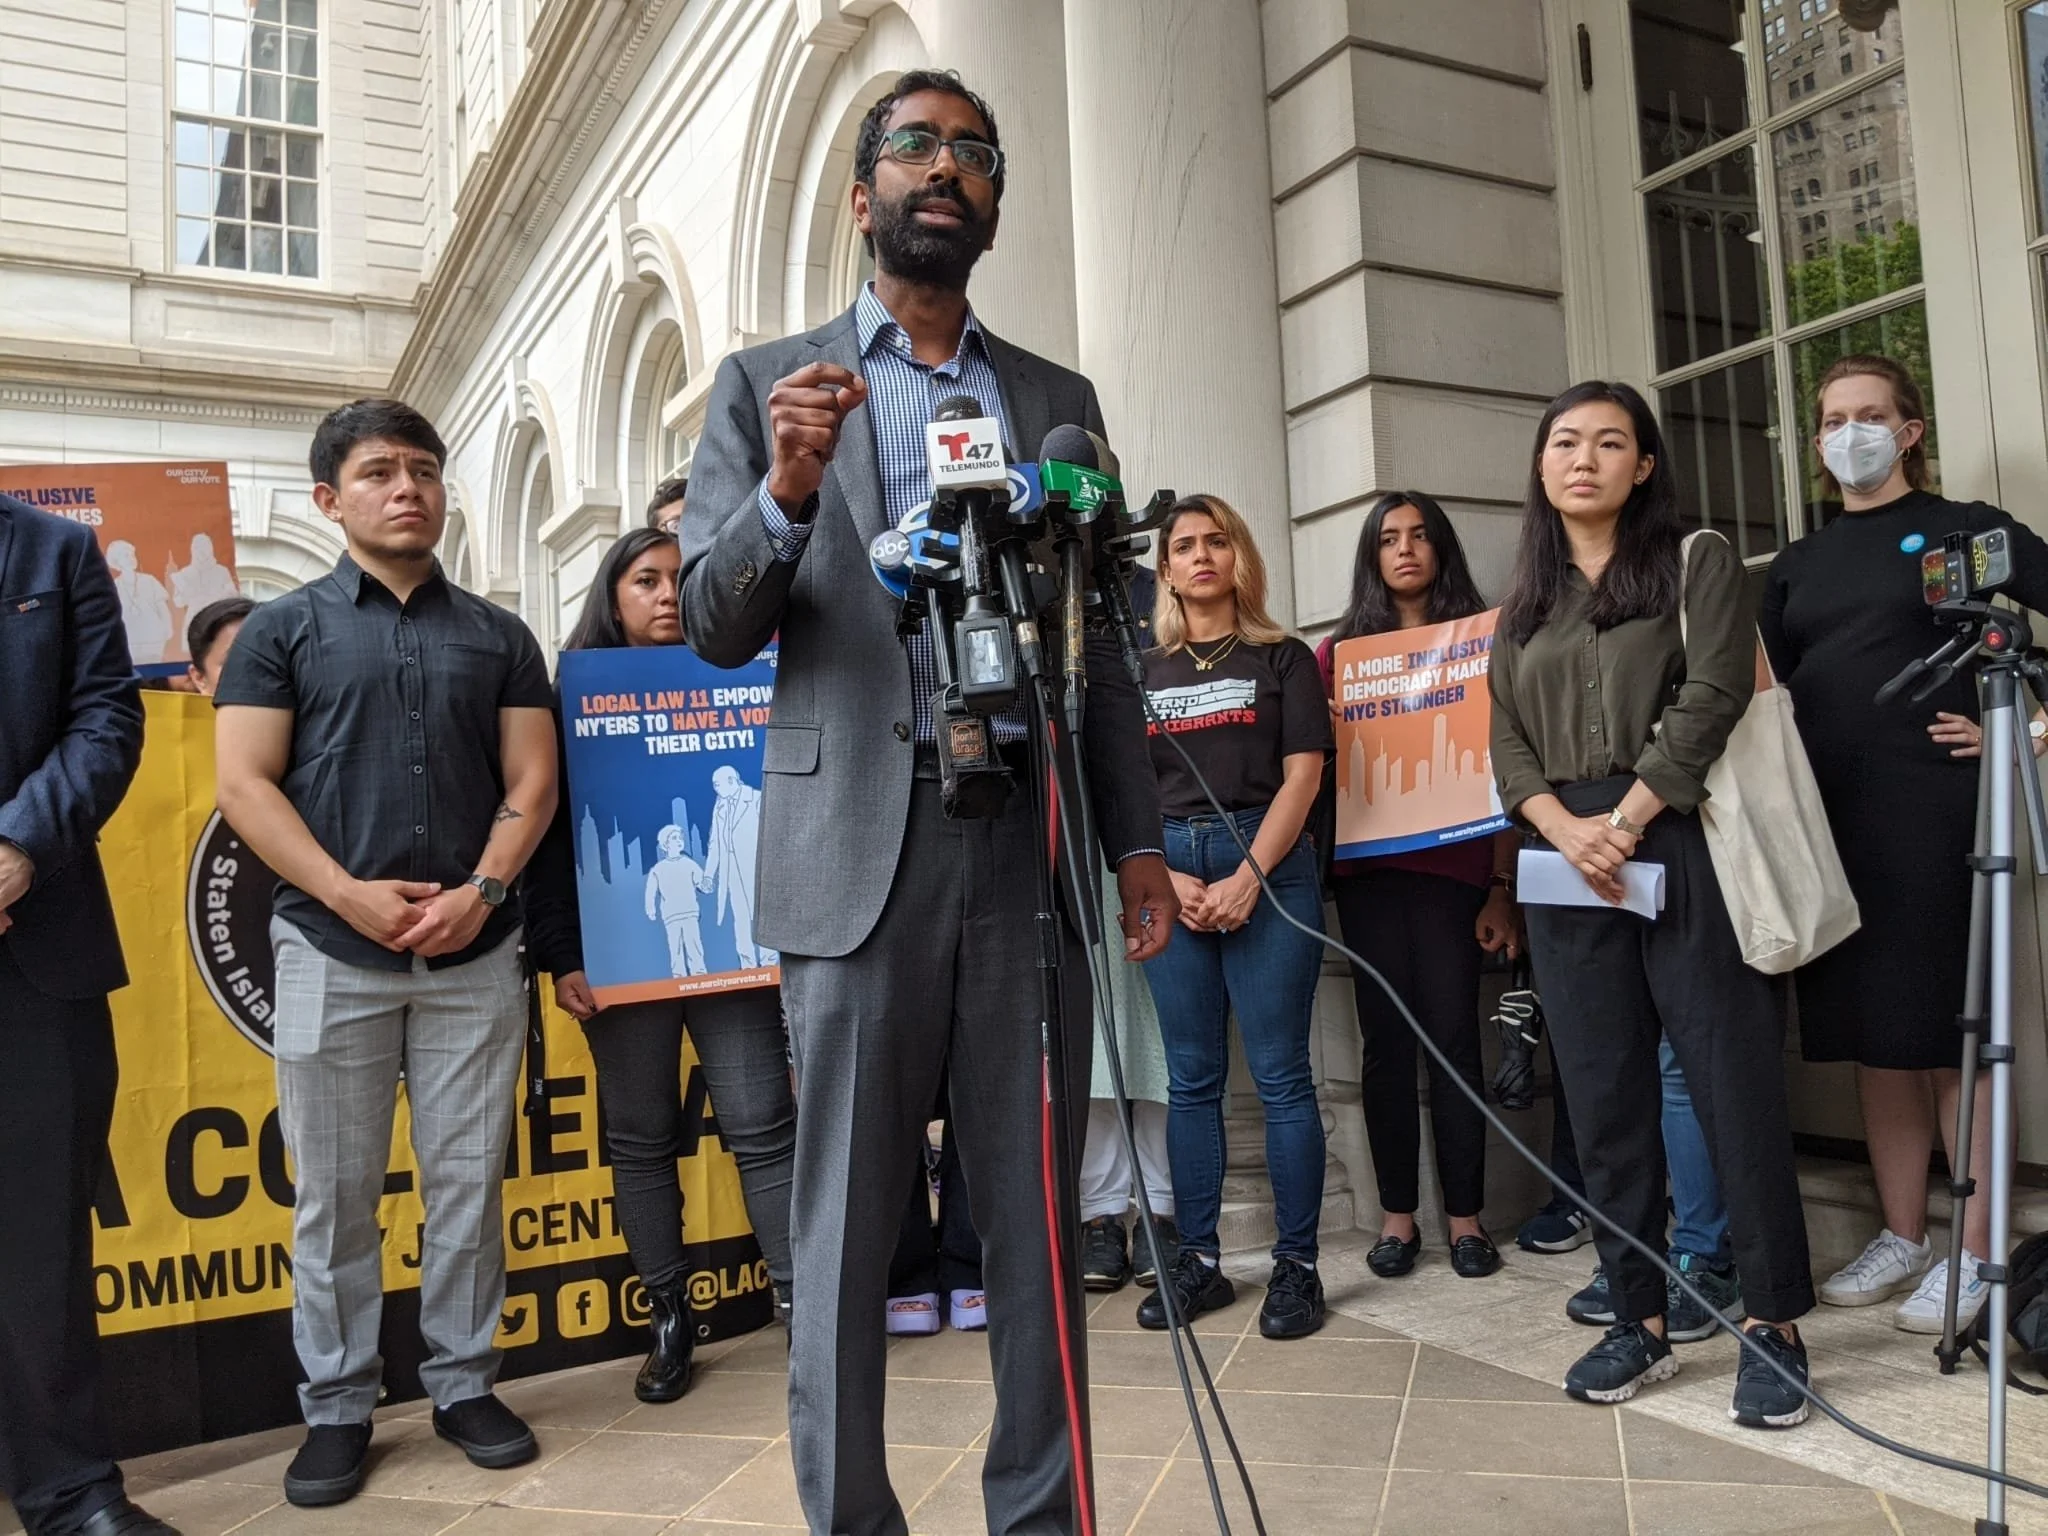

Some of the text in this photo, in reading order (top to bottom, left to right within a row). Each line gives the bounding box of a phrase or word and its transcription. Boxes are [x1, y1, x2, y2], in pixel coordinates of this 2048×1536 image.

[966, 443, 994, 460] 47
[166, 468, 183, 477] OUR
[939, 460, 1000, 473] TELEMUNDO
[181, 476, 199, 484] OUR
[48, 508, 103, 526] KES
[872, 539, 910, 559] abc
[1343, 663, 1354, 681] A
[1358, 654, 1403, 678] MORE
[1343, 655, 1489, 702] DEMOCRACY MAKE
[581, 685, 775, 714] LOCAL LAW 11 EMPOW
[1343, 684, 1465, 723] NYC STRONGER
[575, 707, 772, 737] NY'ERS TO HAVE A VOT
[1147, 709, 1256, 735] MIGRANTS
[645, 729, 755, 755] THEIR CITY!
[207, 855, 276, 1032] Staten Isla
[534, 1078, 543, 1096] NIKE
[686, 1259, 769, 1311] @LAC
